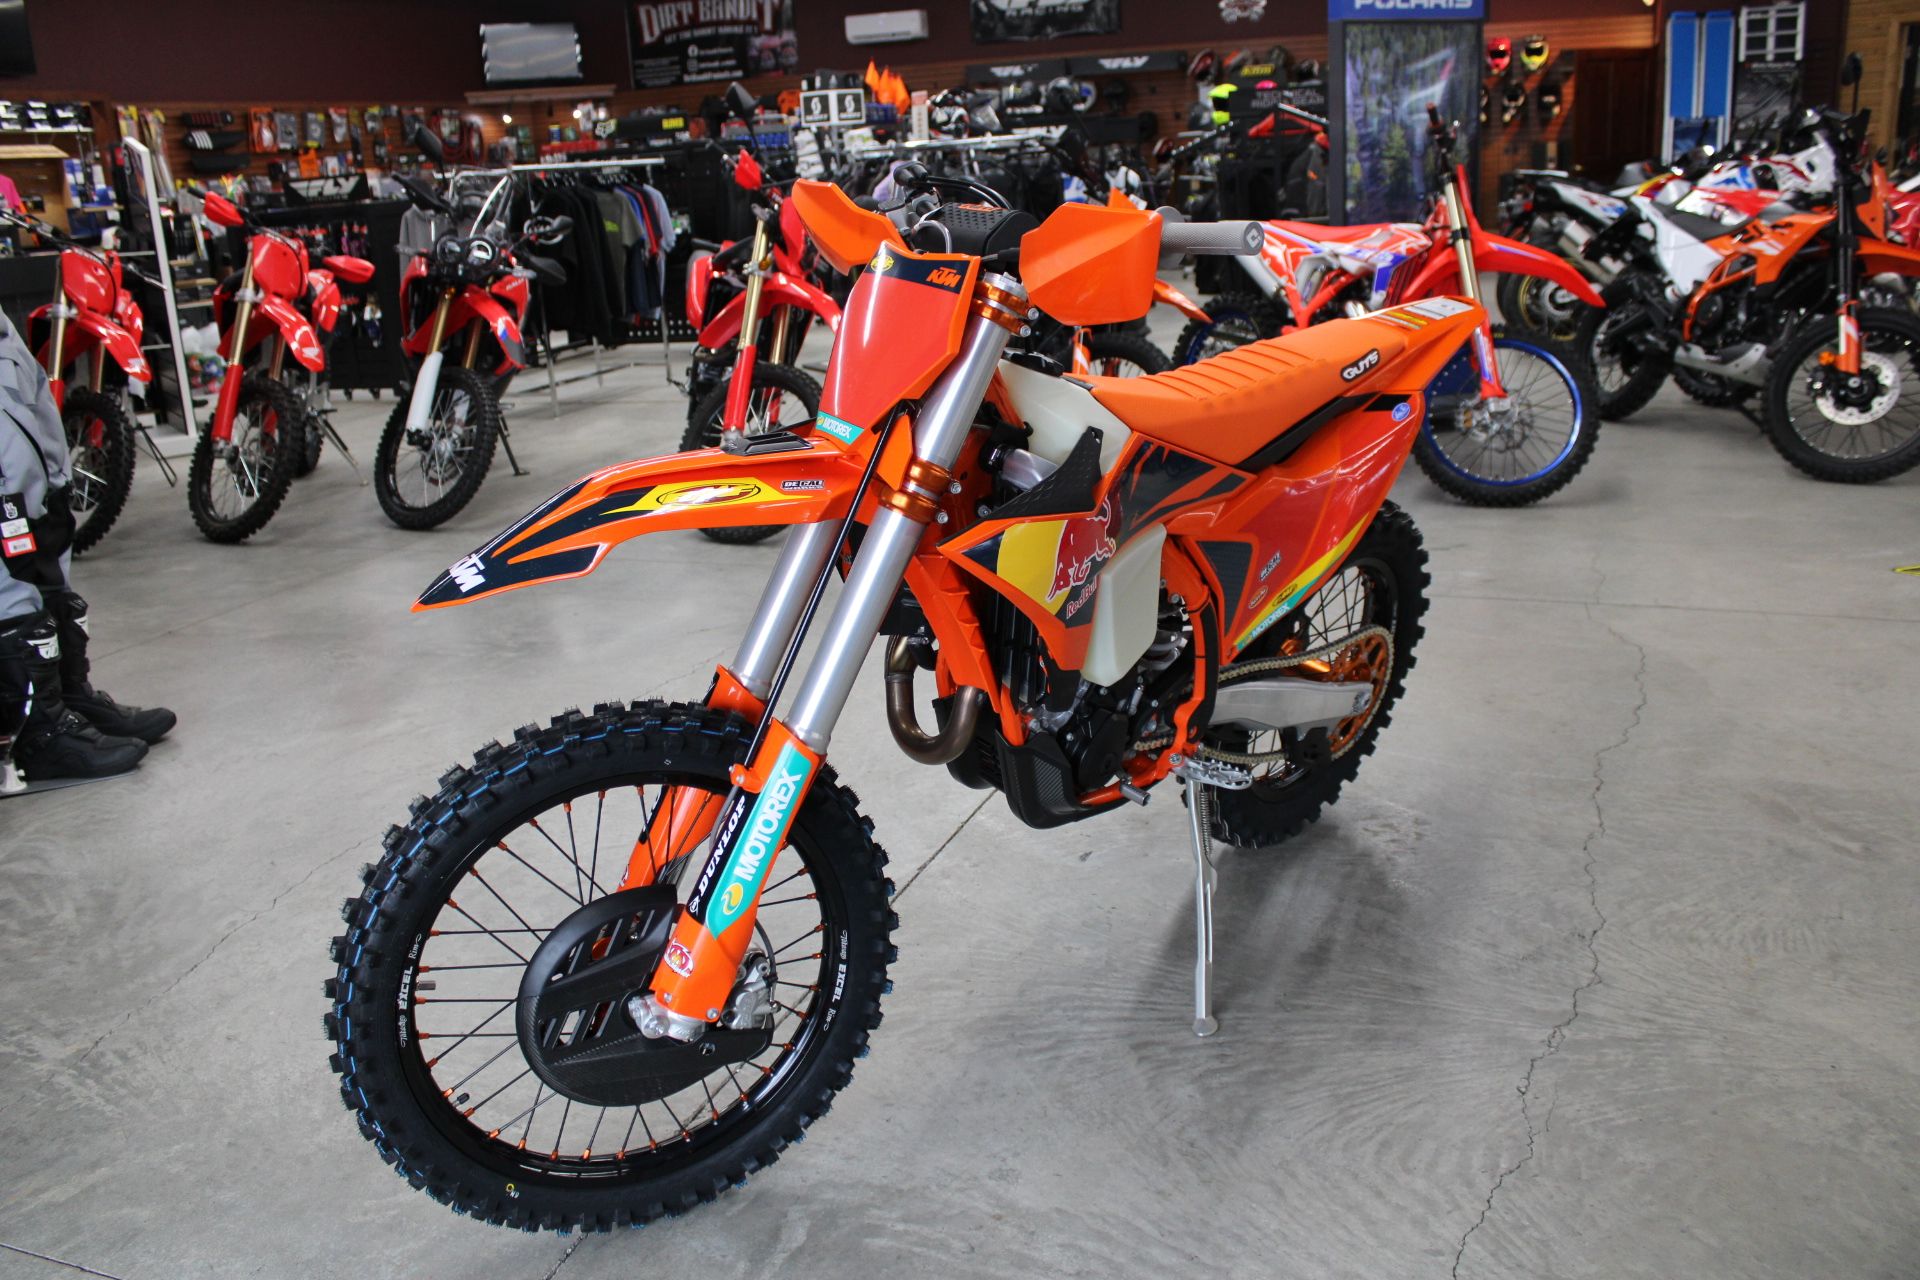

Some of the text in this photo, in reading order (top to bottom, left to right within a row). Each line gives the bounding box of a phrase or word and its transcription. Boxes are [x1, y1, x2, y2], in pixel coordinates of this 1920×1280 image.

[638, 0, 780, 44] DIRT BANDIT
[288, 175, 360, 198] FLY
[926, 266, 963, 289] KTM
[1342, 350, 1379, 380] GUTS
[822, 418, 853, 440] MOTOREX
[1251, 602, 1290, 638] MOTOREX
[733, 768, 802, 882] MOTOREX
[699, 795, 746, 897] DUNLOP
[398, 966, 413, 1010] EXCEL
[832, 963, 847, 1003] EXCEL
